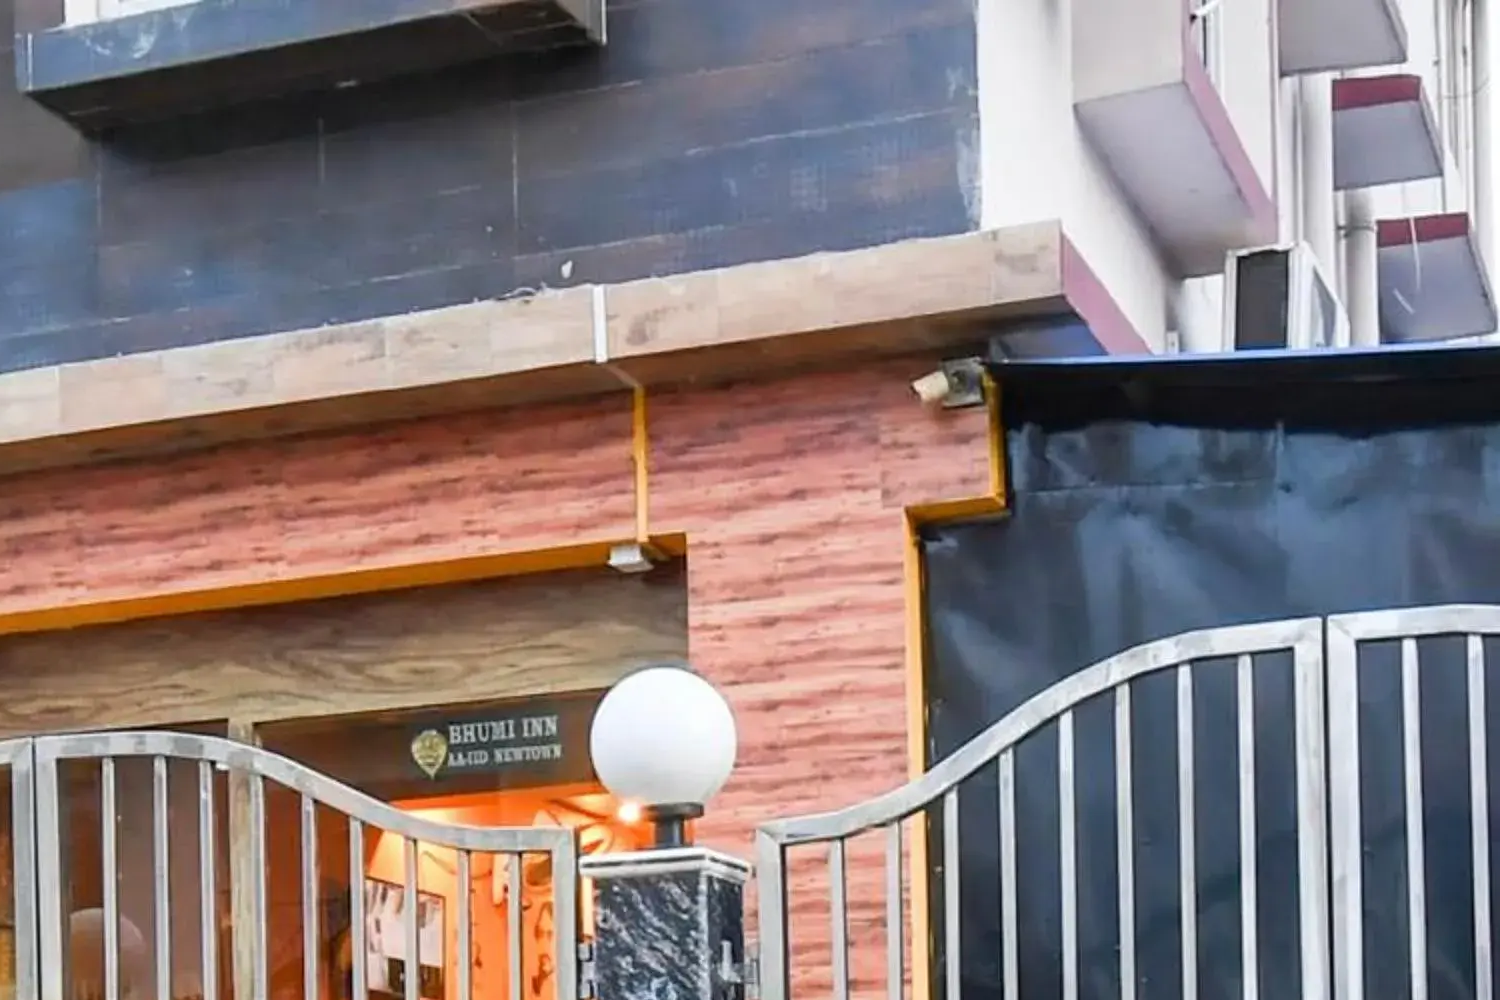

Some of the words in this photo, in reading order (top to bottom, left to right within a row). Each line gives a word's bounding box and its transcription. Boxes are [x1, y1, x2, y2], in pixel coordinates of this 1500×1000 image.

[449, 719, 515, 744] BHUMI
[522, 714, 558, 738] INN
[493, 744, 562, 763] NEWTOWN
